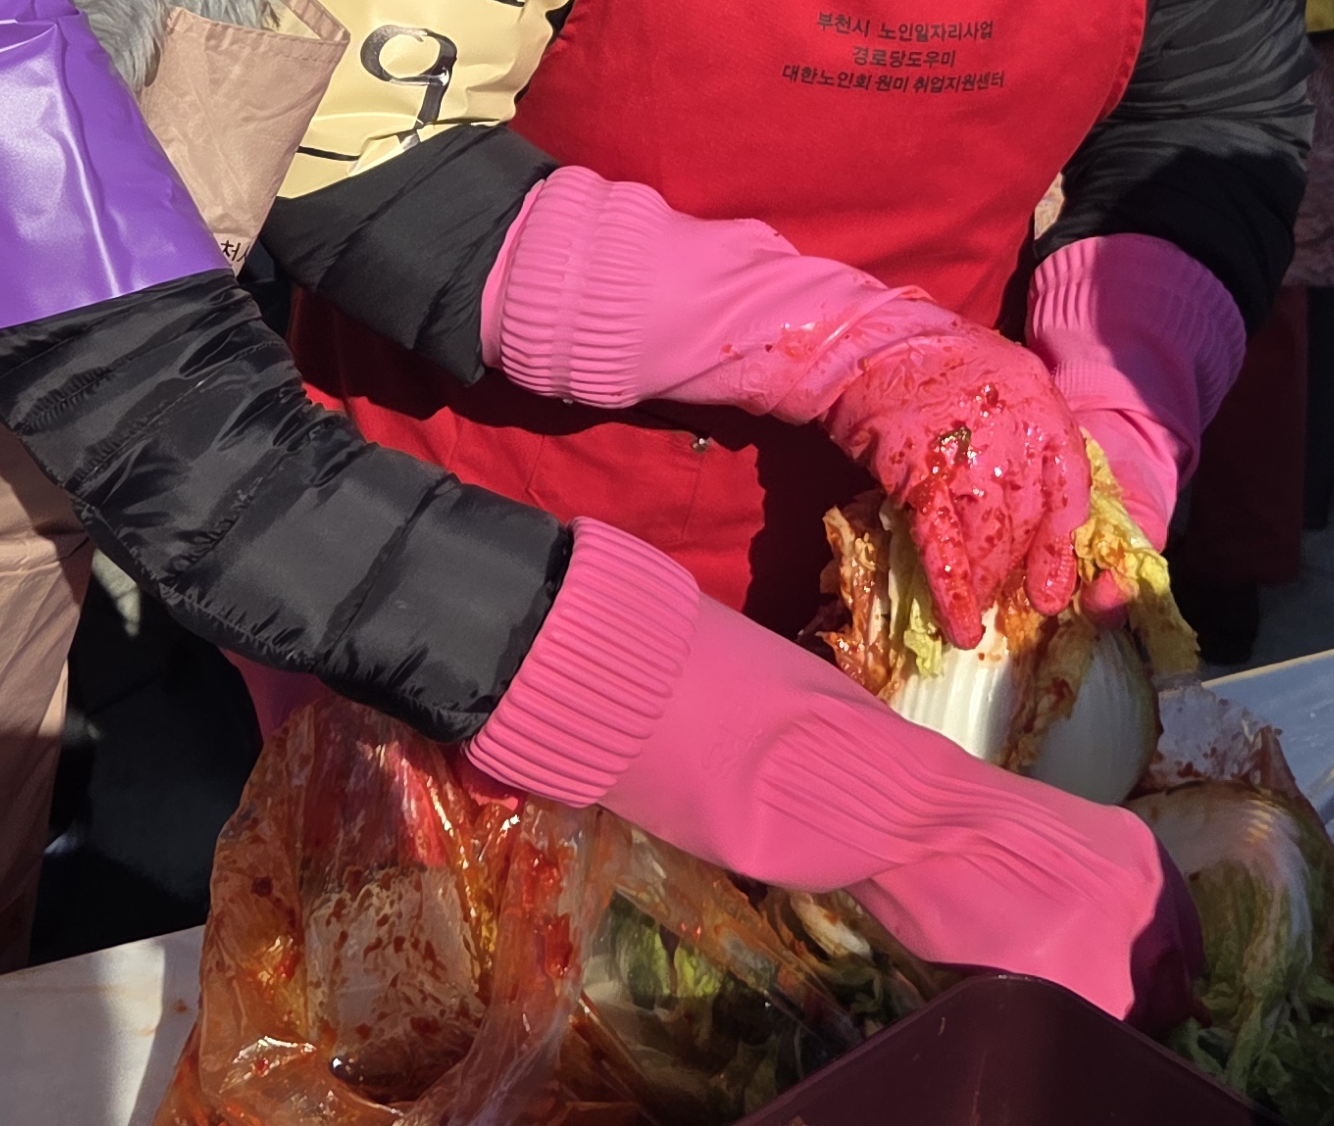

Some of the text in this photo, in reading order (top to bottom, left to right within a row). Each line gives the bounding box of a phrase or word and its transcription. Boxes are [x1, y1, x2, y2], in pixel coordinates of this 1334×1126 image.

[817, 12, 994, 42] 부천시 노인일자리사업
[852, 45, 956, 68] 경로당도우미
[781, 64, 871, 91] 대한노인회
